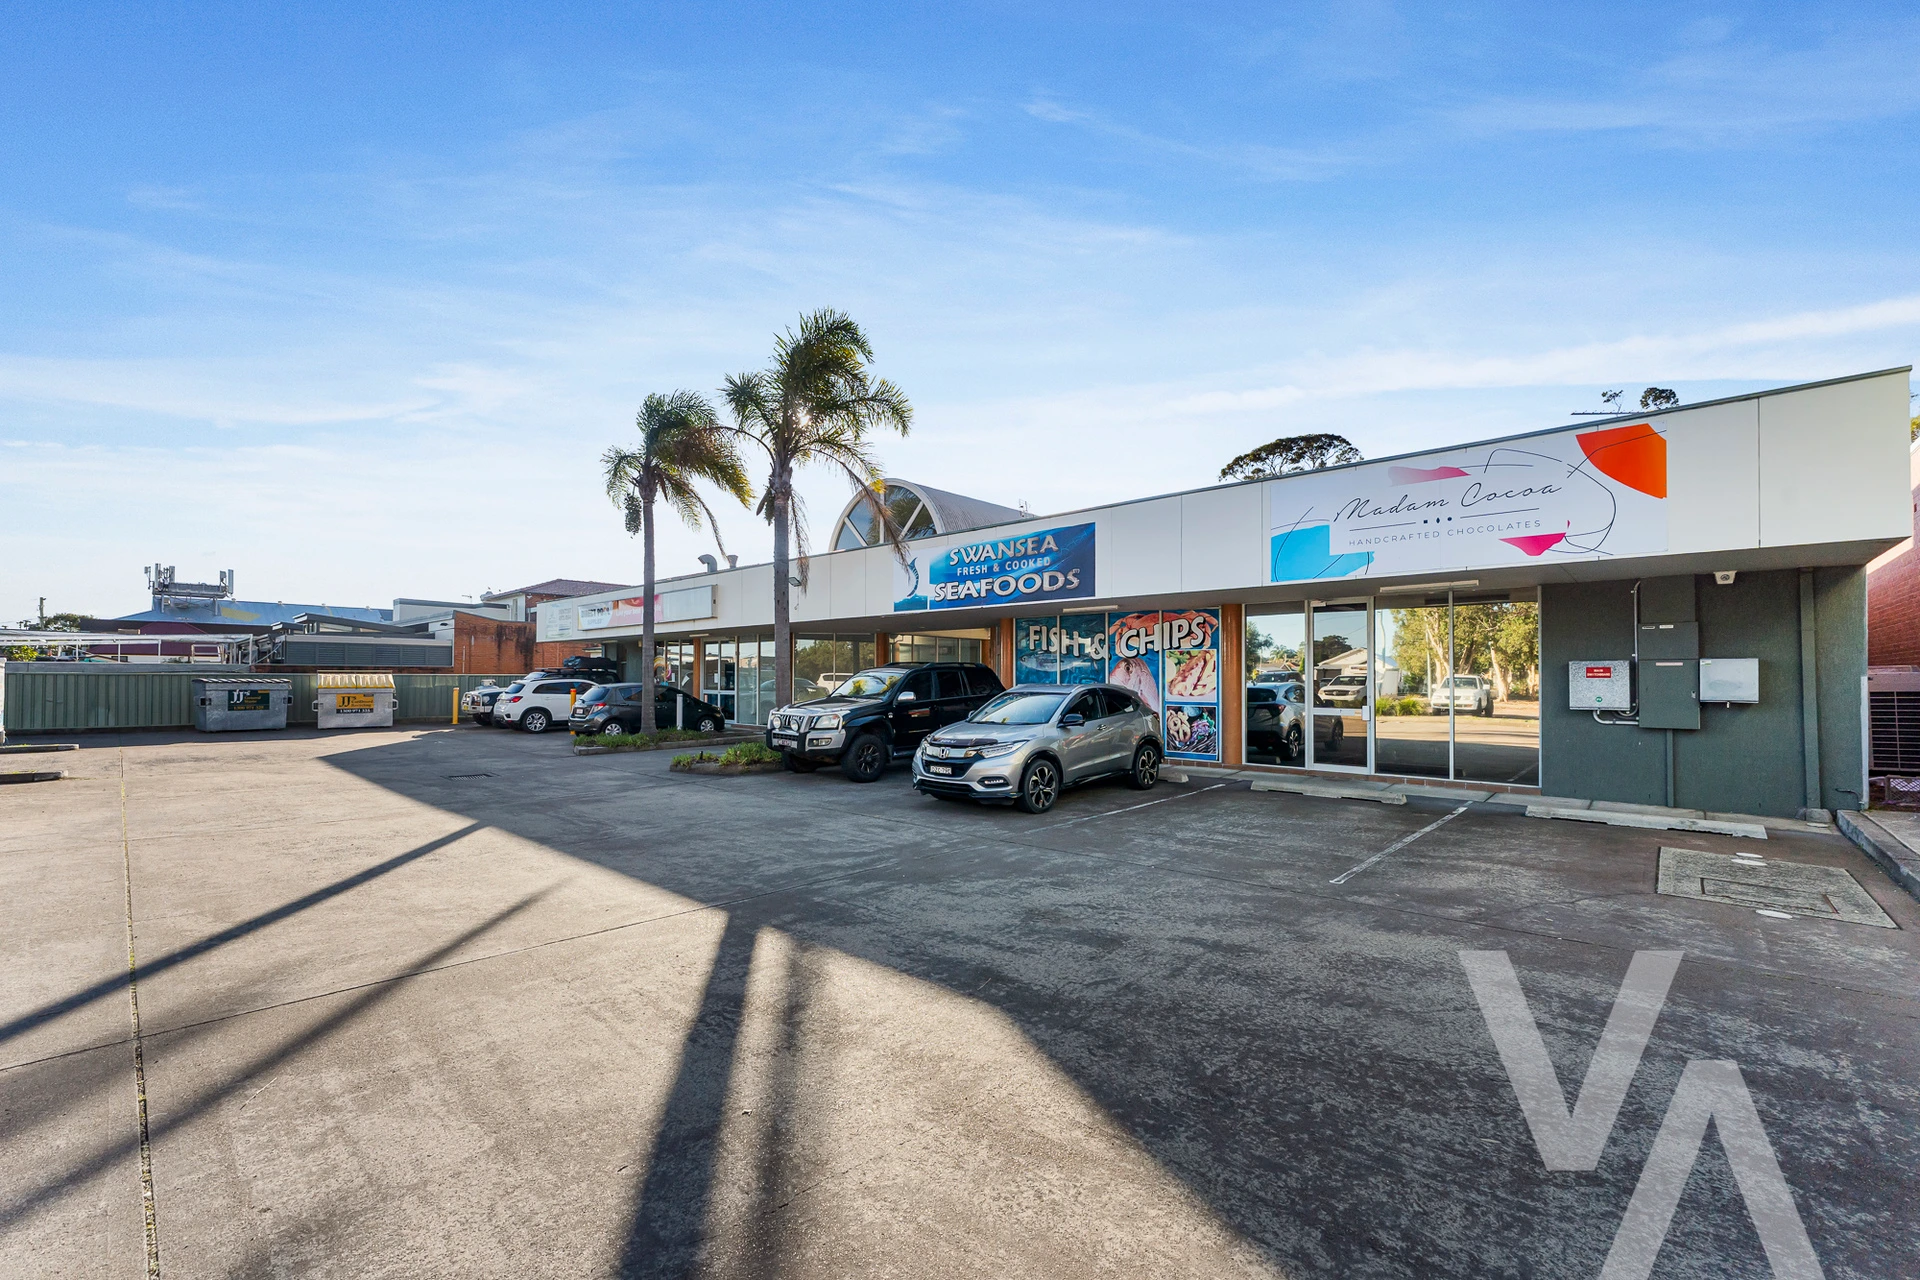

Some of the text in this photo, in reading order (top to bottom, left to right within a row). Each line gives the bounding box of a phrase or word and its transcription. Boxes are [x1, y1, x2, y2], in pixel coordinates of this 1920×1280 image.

[1333, 482, 1563, 522] Madam Cocoa
[1349, 520, 1541, 546] HANDCRAFTED CHOCOLATES
[949, 534, 1059, 566] SWANSEA
[957, 556, 1051, 576] FRESH & COOKED
[934, 568, 1081, 602] SEAFOODS
[1029, 616, 1207, 661] FISH & CHIPS
